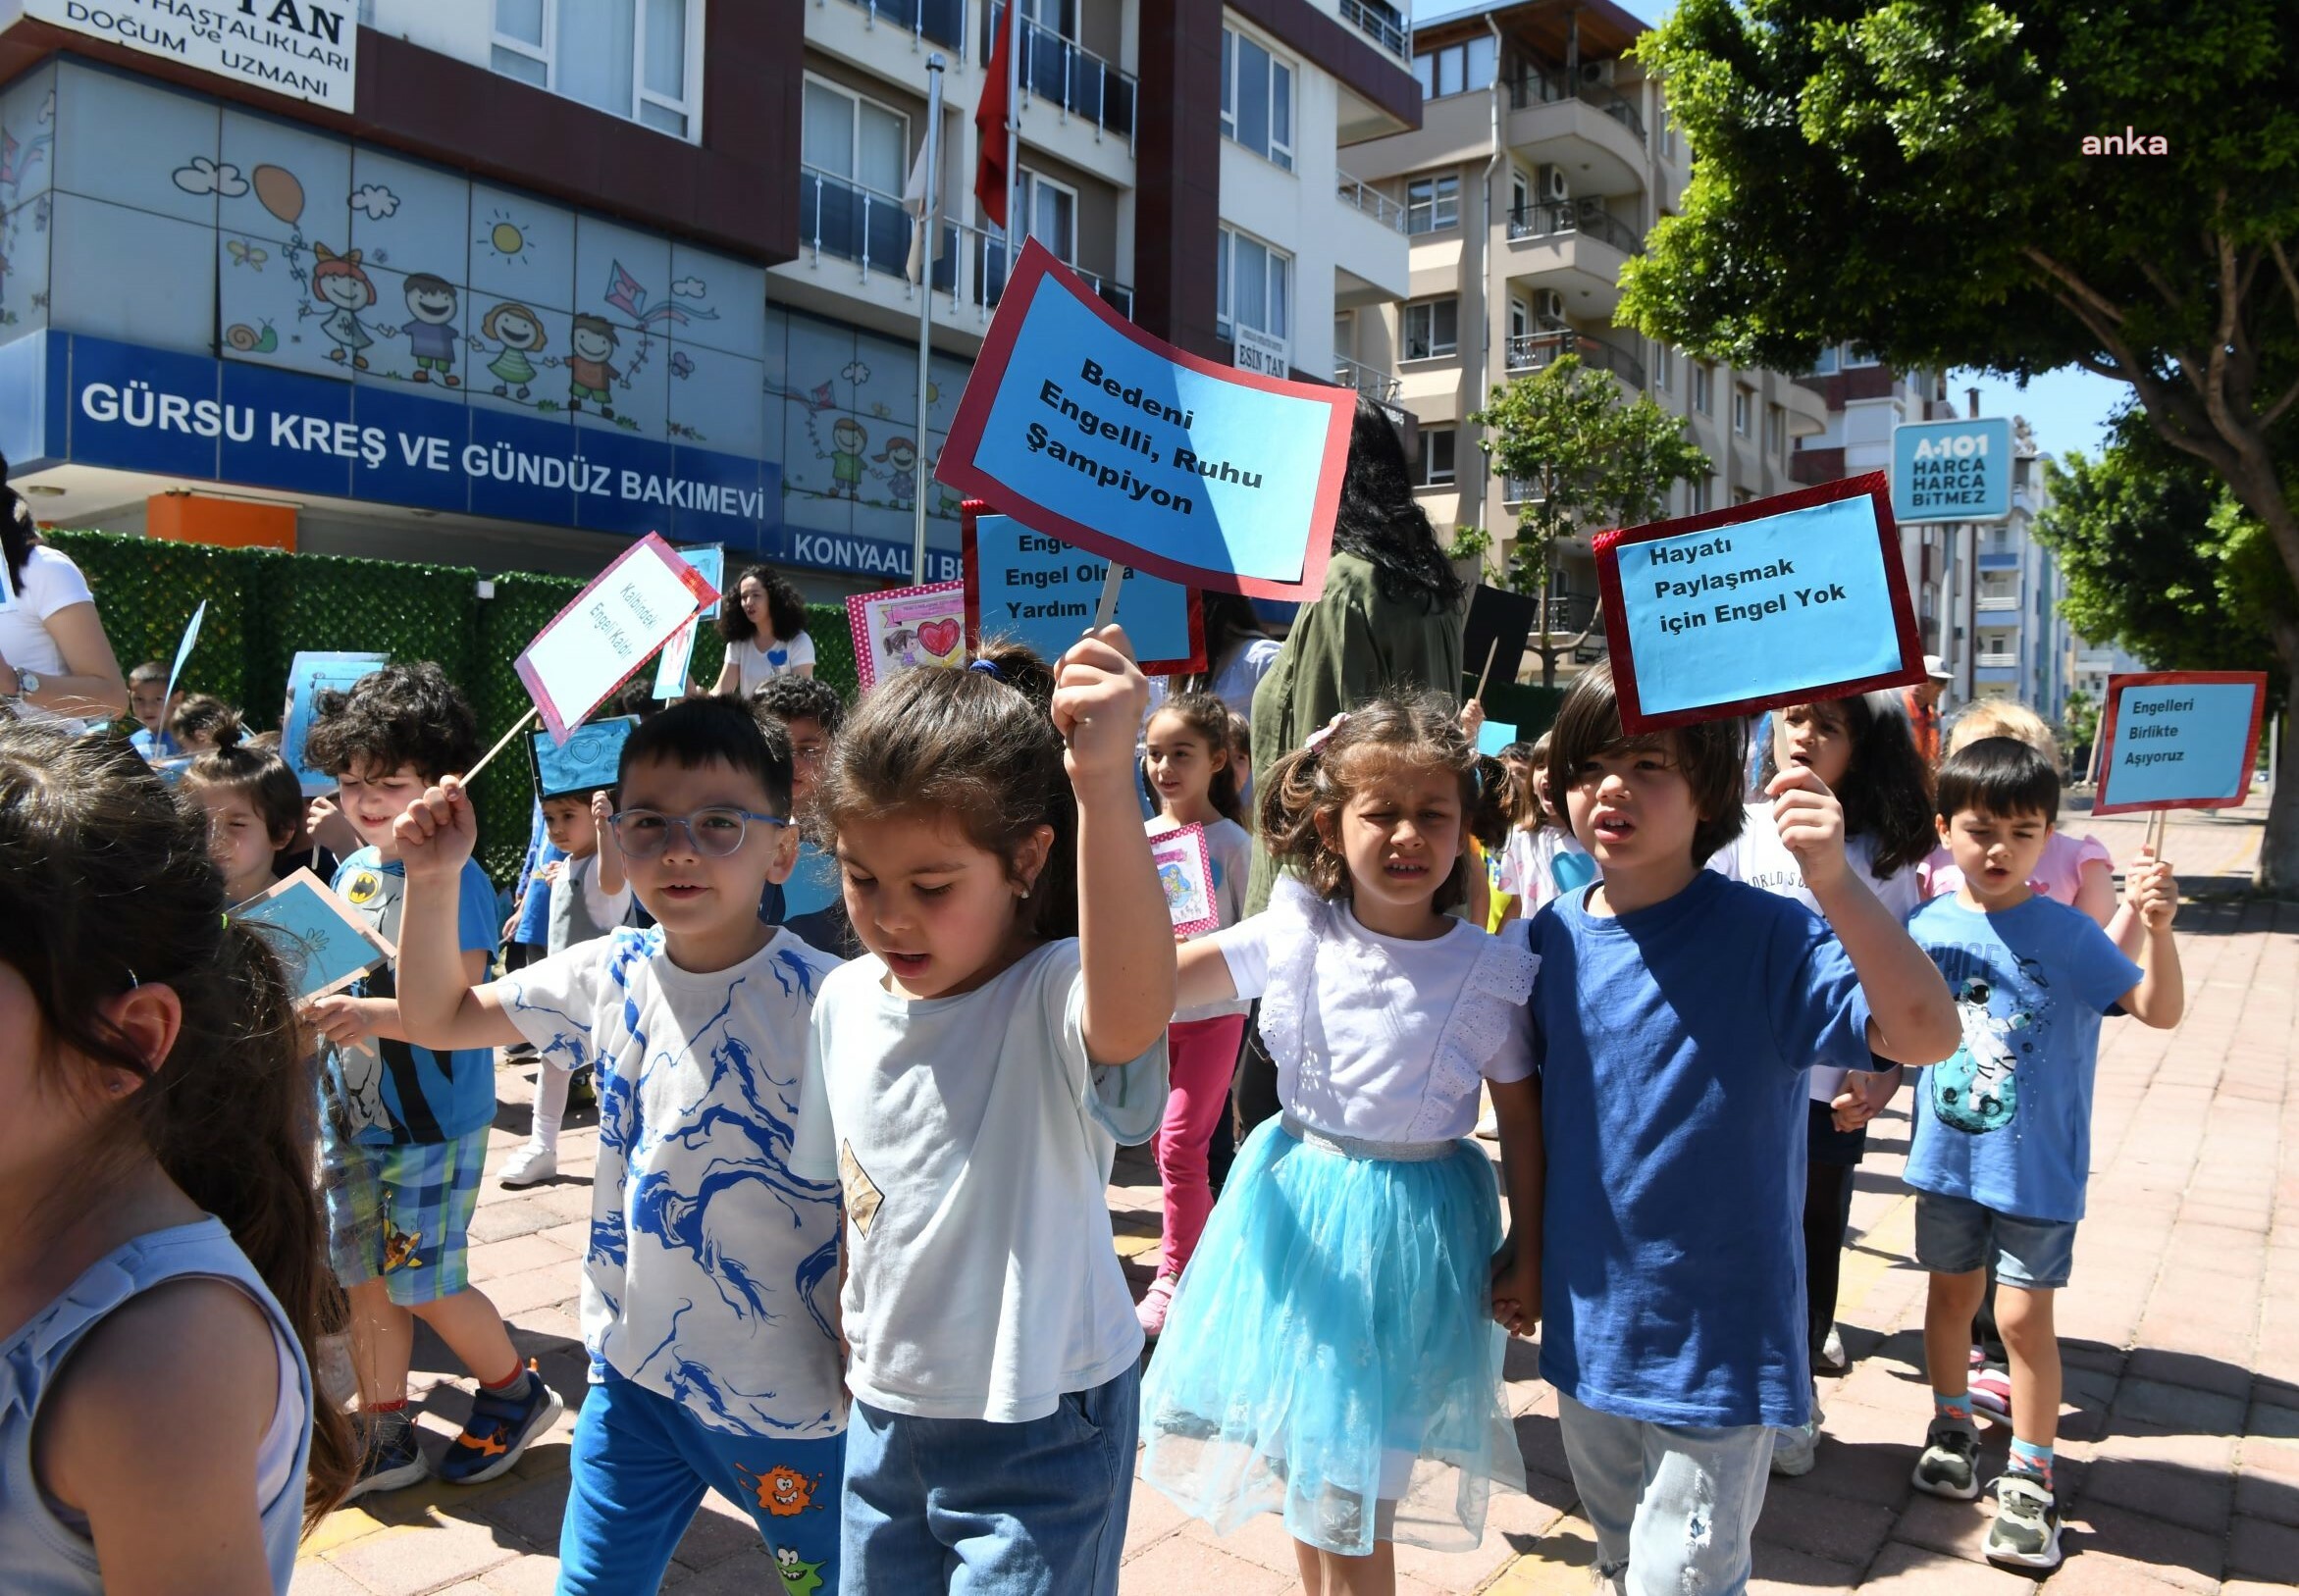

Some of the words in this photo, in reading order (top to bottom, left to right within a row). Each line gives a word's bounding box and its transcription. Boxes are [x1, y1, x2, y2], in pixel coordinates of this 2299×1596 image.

[190, 25, 222, 43] ve
[67, 2, 186, 53] DOĞUM
[221, 50, 328, 97] UZMANI
[1266, 354, 1284, 379] TAN
[1080, 357, 1194, 430] Bedeni
[1039, 379, 1160, 463] Engelli,
[1173, 447, 1263, 489] Ruhu
[81, 380, 254, 441] GÜRSU
[271, 412, 387, 469] KREŞ
[398, 432, 450, 472] VE
[462, 441, 611, 496] GÜNDÜZ
[621, 470, 764, 520] BAKIMEVİ
[1025, 422, 1193, 515] Şampiyon
[1913, 458, 1986, 475] HARCA
[1912, 475, 1985, 490] HARCA
[795, 533, 933, 578] KONYAALI
[1649, 537, 1732, 566] Hayatı
[1006, 566, 1069, 589] Engel
[1076, 564, 1134, 582] Ola
[1654, 558, 1796, 598] Paylaşmak
[590, 602, 618, 635] Engeli
[1006, 600, 1087, 619] Yardım
[1660, 611, 1706, 636] için
[1715, 594, 1787, 621] Engel
[1795, 584, 1847, 607] Yok
[2132, 697, 2195, 716] Engelleri
[2128, 725, 2179, 740] Birlikte
[2124, 751, 2185, 767] Aşıyoruz
[1747, 871, 1783, 888] ORLD
